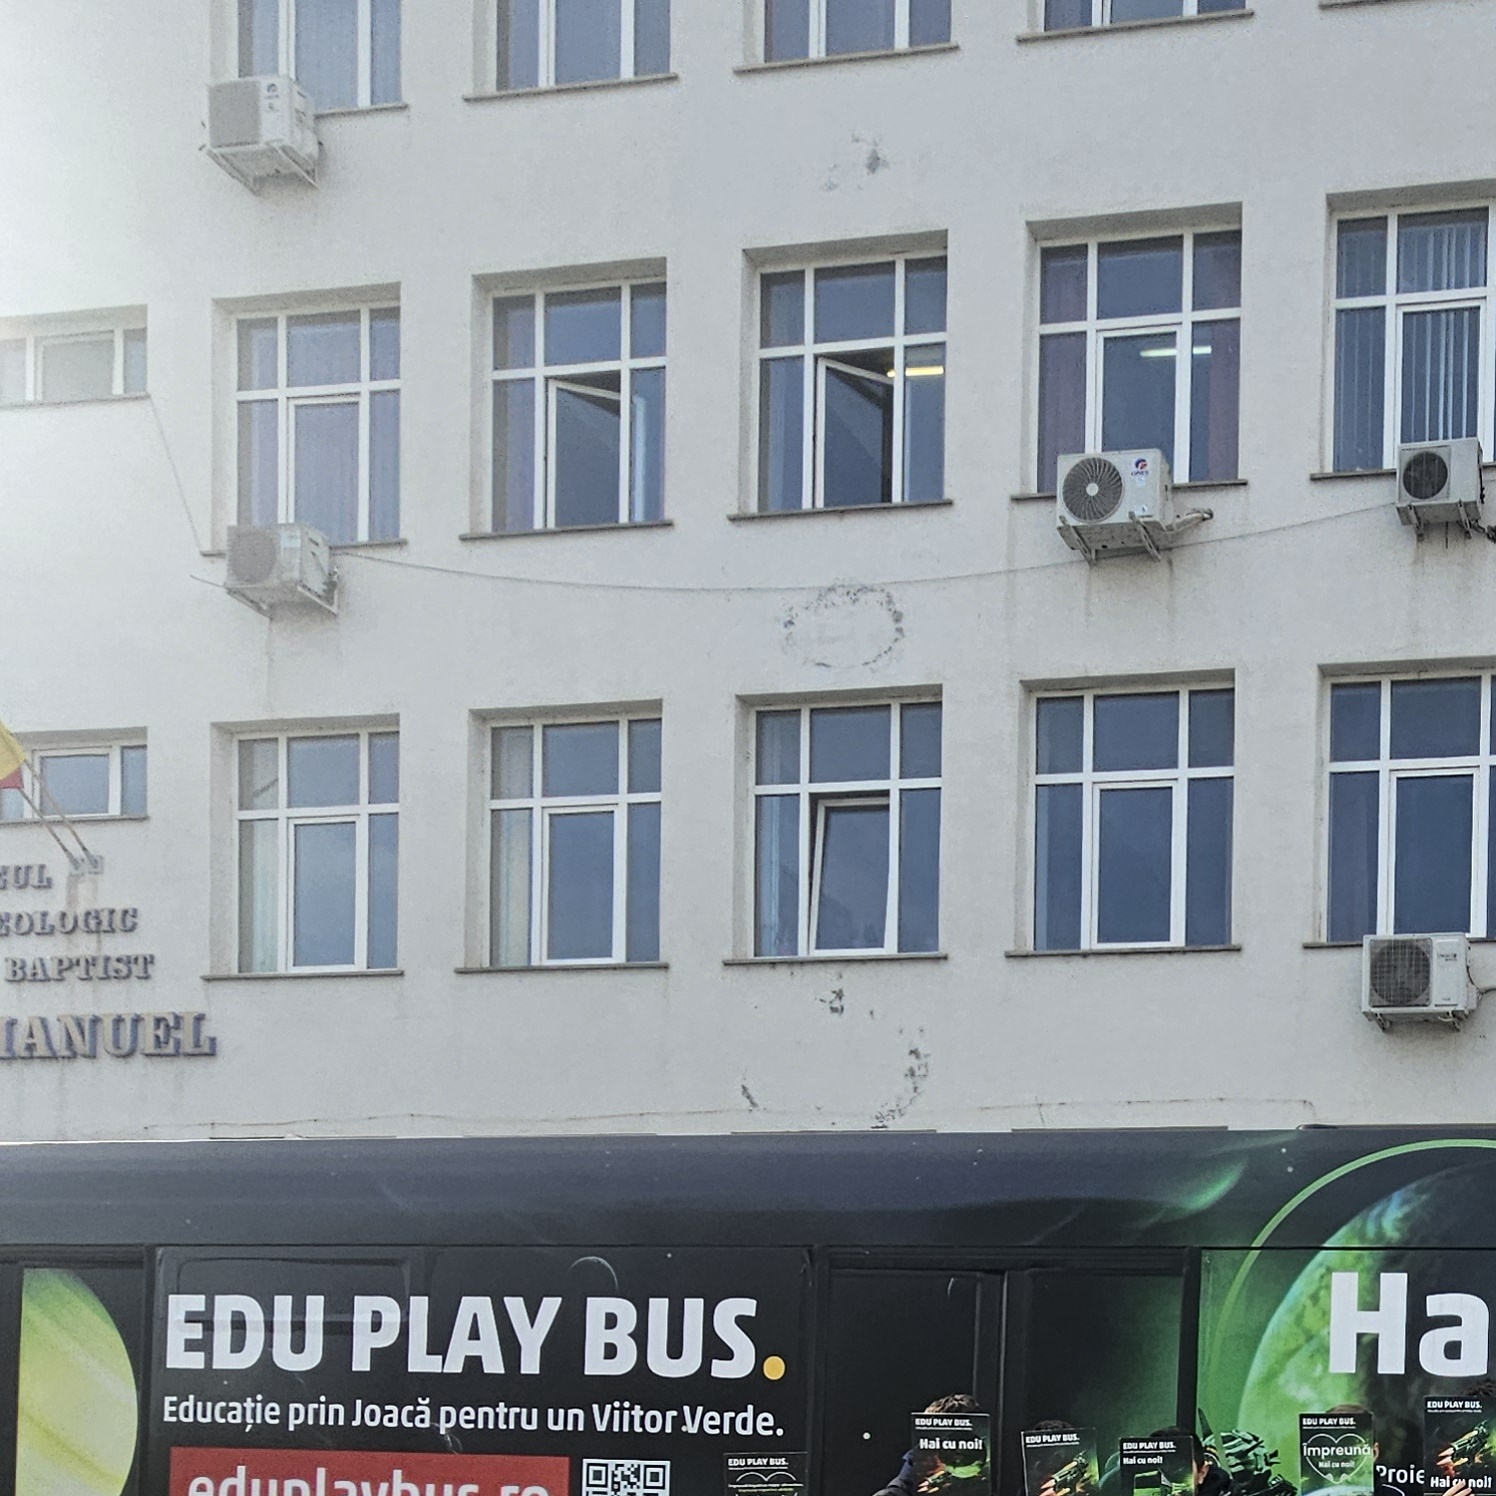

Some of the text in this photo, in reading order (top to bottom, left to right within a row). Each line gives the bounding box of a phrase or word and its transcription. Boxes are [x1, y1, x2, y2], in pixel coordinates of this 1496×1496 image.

[4, 954, 155, 982] BAPTIST
[166, 1295, 785, 1380] EDU PLAY BUS.
[163, 1394, 784, 1437] Educație prin Joacă pentru un Viitor Verde.
[919, 1438, 983, 1450] Hai cu noi!
[1302, 1442, 1371, 1460] Împreună
[1430, 1475, 1450, 1488] Hai
